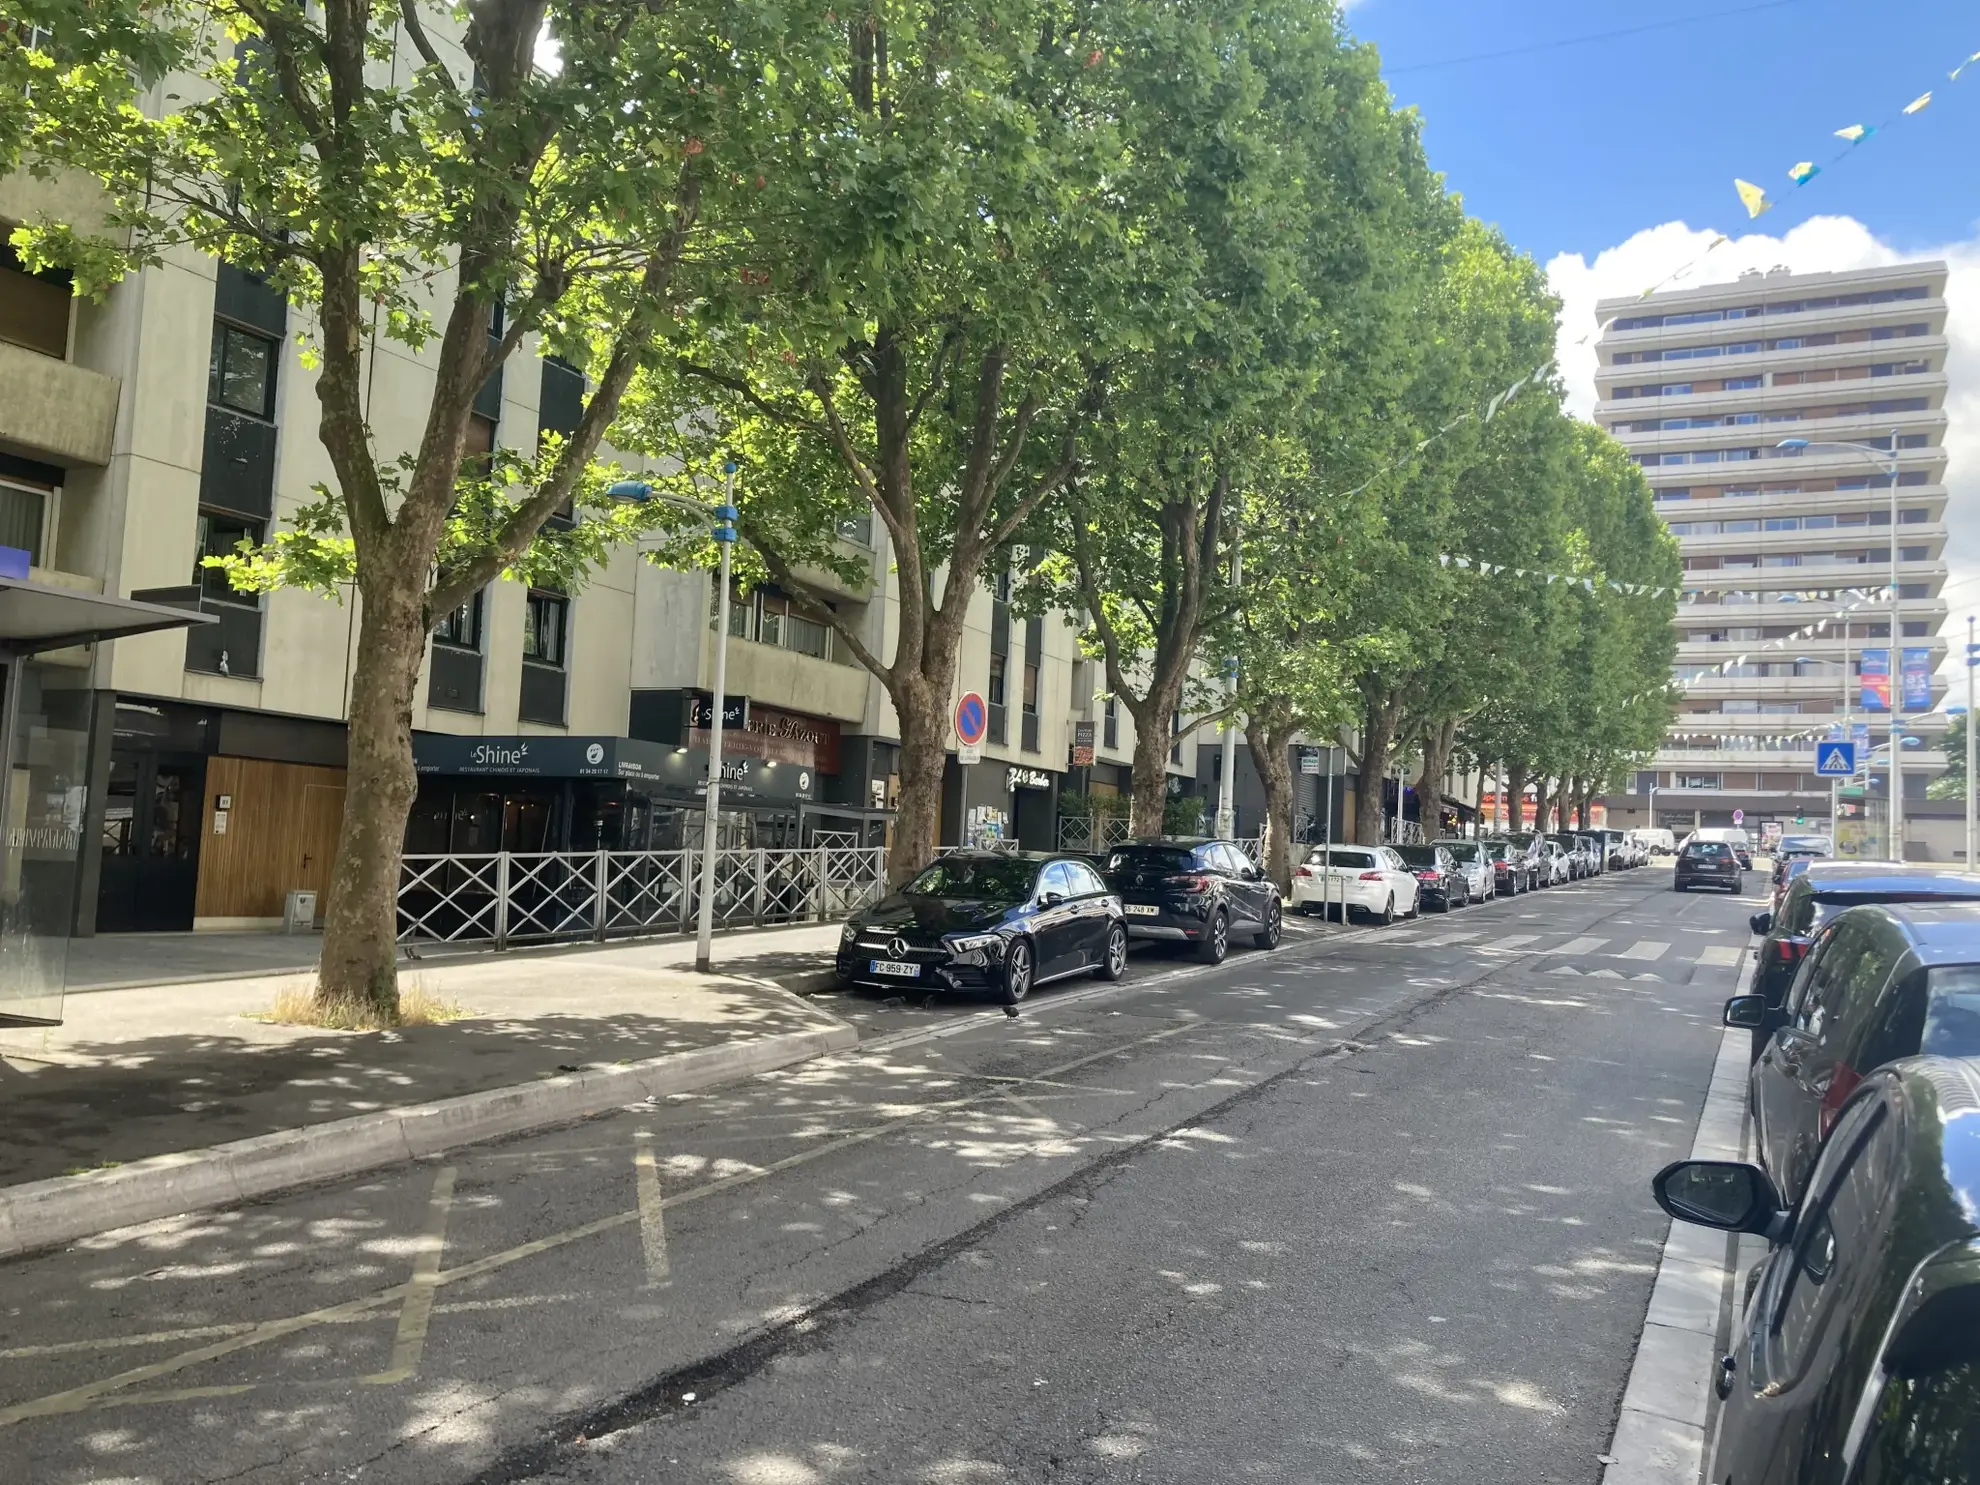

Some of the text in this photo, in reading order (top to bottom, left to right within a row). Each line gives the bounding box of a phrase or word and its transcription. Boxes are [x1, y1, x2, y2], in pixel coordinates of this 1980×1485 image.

[705, 708, 735, 720] Sne
[476, 745, 521, 764] Shine
[421, 765, 441, 773] emporter
[618, 761, 642, 771] LIVRAISON
[719, 760, 744, 781] hine
[875, 962, 914, 975] FC 959 ZY
